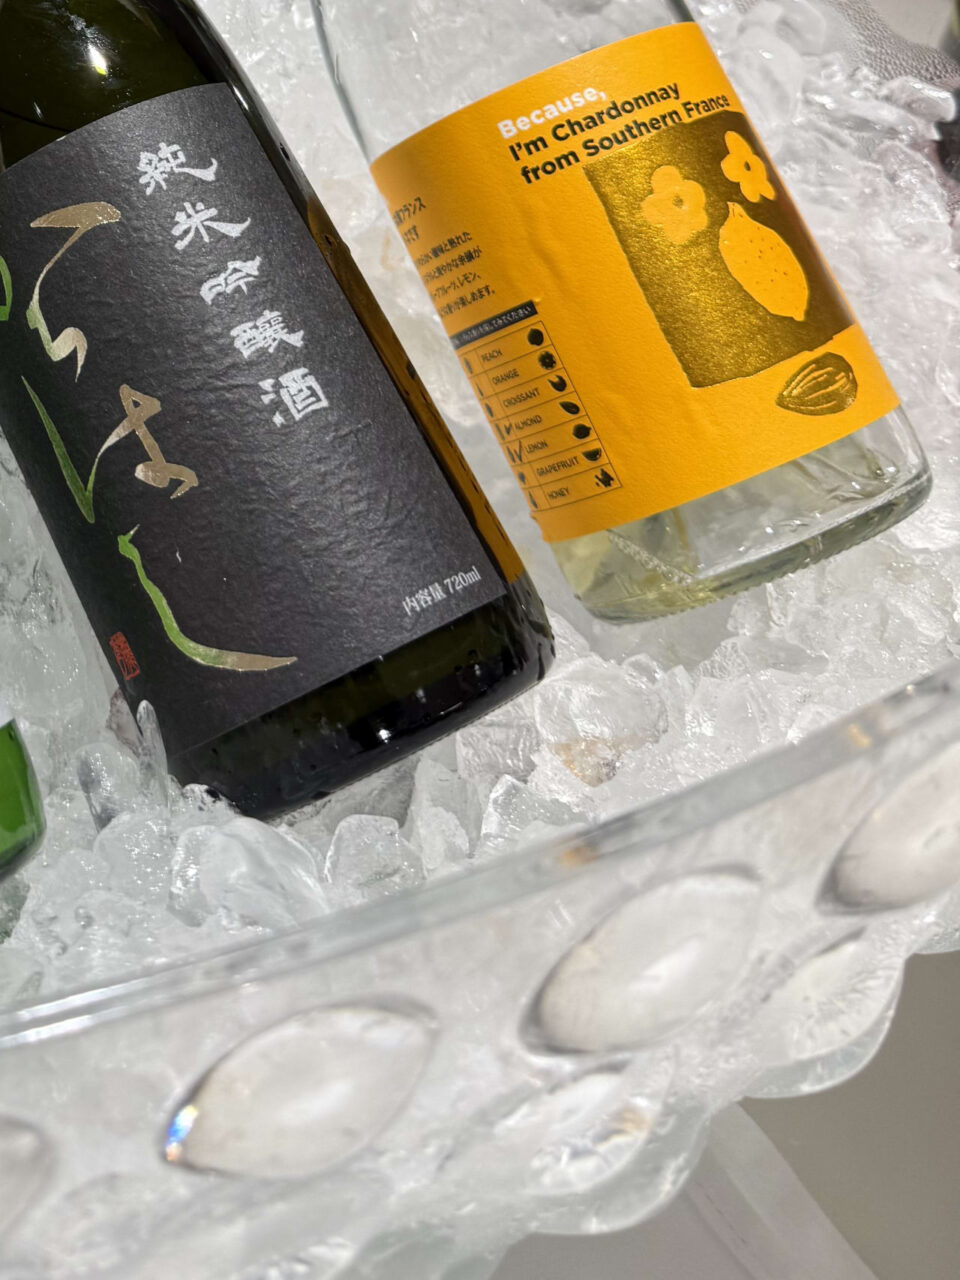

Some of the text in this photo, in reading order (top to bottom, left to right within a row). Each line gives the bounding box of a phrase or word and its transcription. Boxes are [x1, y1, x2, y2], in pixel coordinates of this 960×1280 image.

[497, 87, 607, 139] Because,
[551, 83, 680, 142] Chardonnay
[520, 94, 731, 184] from Southern France
[482, 349, 502, 362] PEACH
[492, 369, 519, 385] ORANGE
[503, 388, 540, 408] CROISSANT
[515, 415, 543, 431] ALMOND
[525, 440, 548, 454] LEMON
[537, 456, 579, 476] GRAPEFRUIT
[548, 487, 570, 500] HONEY
[401, 564, 482, 617] 内容量 720ml
